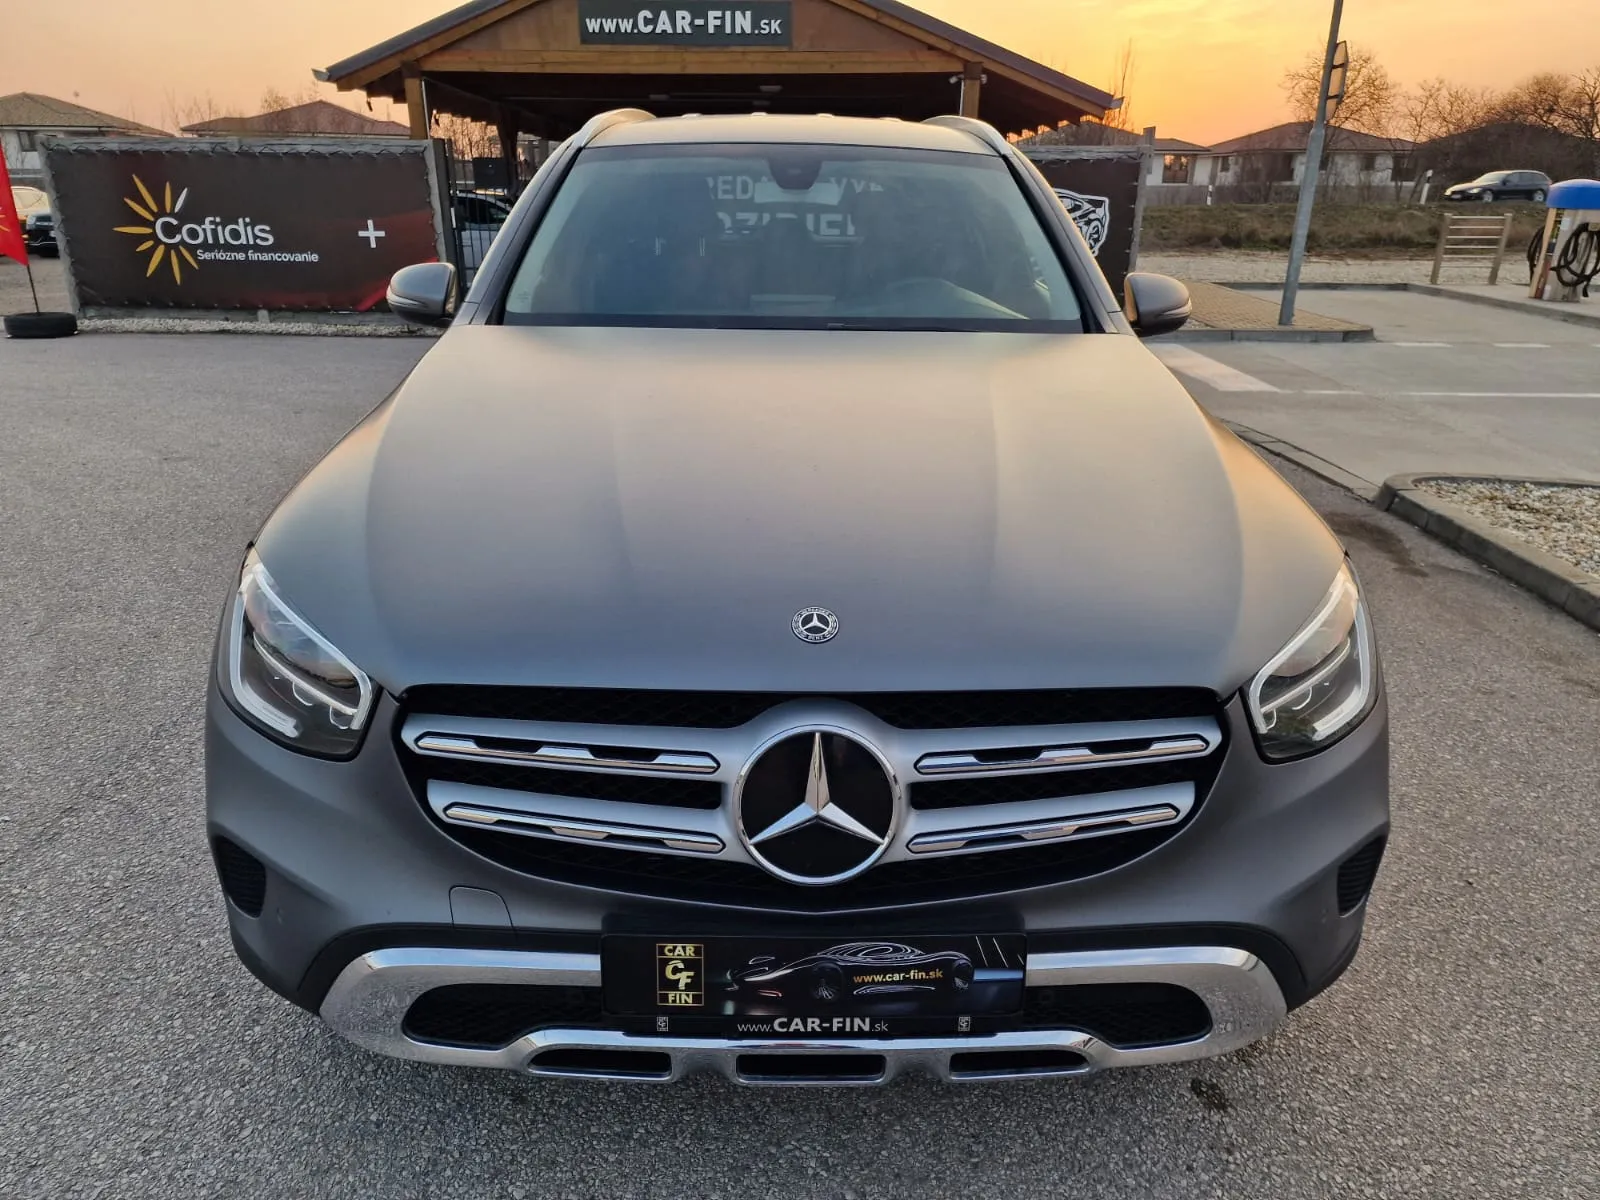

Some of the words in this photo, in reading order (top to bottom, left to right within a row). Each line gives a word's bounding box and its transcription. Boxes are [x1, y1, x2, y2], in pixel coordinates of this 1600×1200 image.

[154, 215, 275, 246] Cofidis
[196, 248, 246, 261] Seriózne
[248, 249, 319, 263] financovanie
[663, 944, 696, 957] CAR
[852, 968, 944, 984] www.car-fin.sk
[667, 993, 693, 1004] FIN
[737, 1016, 889, 1033] www.CAR-FIN.sk
